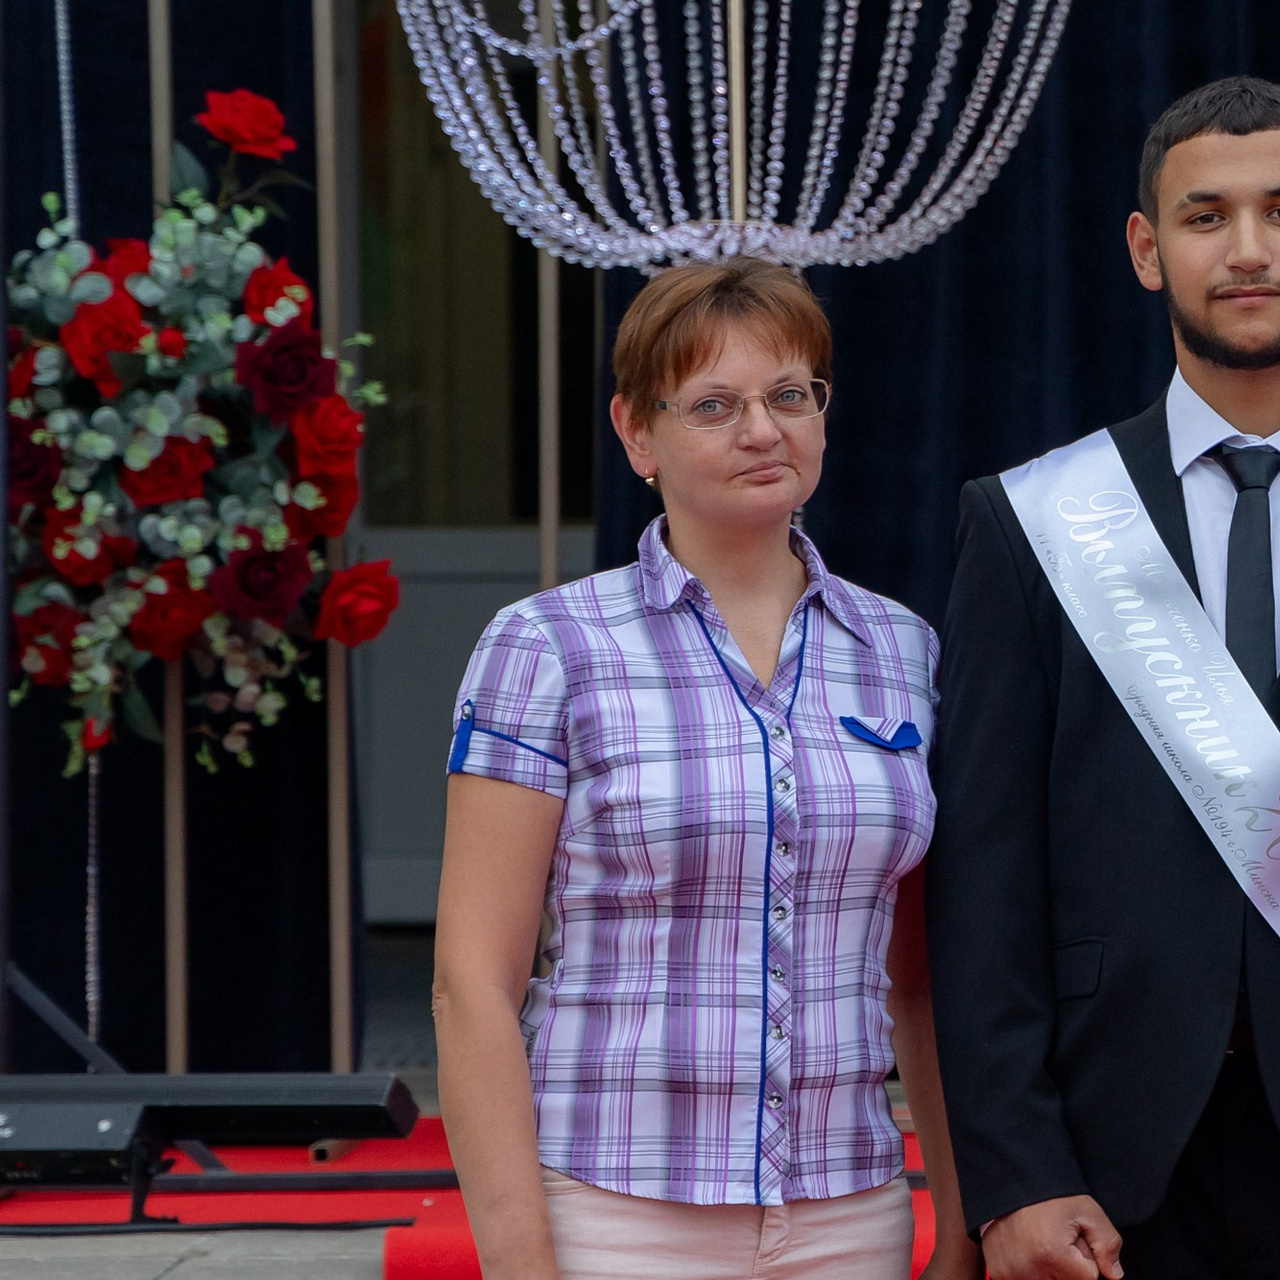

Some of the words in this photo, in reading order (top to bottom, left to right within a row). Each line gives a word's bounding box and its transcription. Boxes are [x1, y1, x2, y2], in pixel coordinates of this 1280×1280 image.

[1061, 582, 1088, 618] класс
[1056, 490, 1259, 798] Выпускник
[1202, 650, 1238, 706] Илья
[1161, 741, 1193, 785] школа
